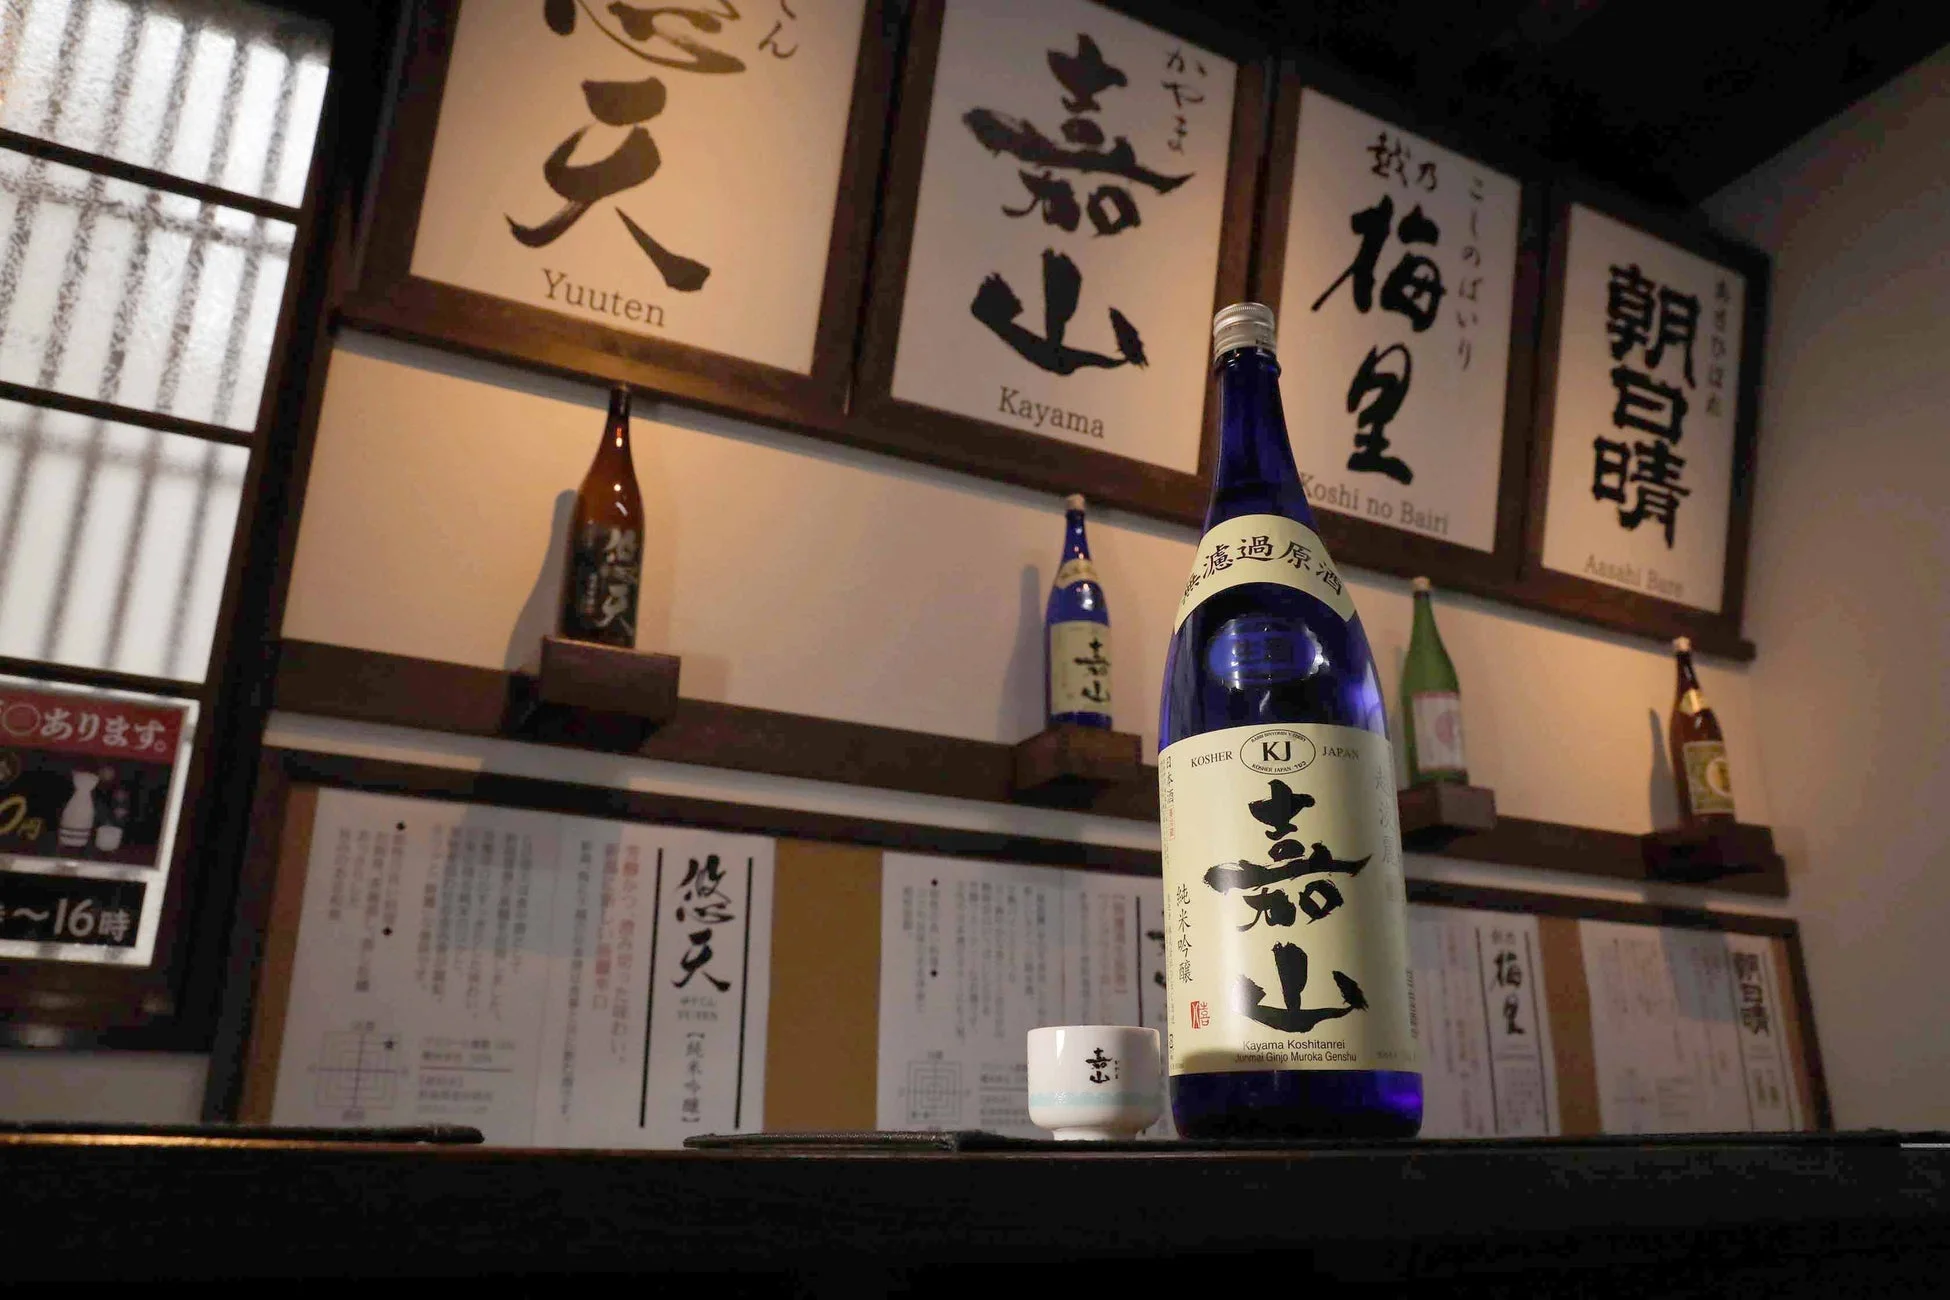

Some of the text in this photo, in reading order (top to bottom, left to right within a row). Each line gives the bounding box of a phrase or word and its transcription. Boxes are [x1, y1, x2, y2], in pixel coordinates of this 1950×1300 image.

[963, 33, 1196, 376] 嘉山
[541, 267, 667, 328] Yuuten
[1310, 194, 1447, 486] 梅里
[997, 386, 1106, 439] Kayama
[1591, 262, 1701, 550] 朝日晴
[1366, 496, 1394, 519] no
[1190, 751, 1234, 768] KOSHER
[1263, 741, 1292, 762] KJ
[1322, 746, 1360, 761] JAPAN
[1251, 763, 1273, 773] KOSHER
[1203, 778, 1373, 1033] 嘉山
[1235, 1051, 1357, 1064] Junmai Ginjo Muroka Genshu
[1243, 1039, 1346, 1052] Kayama Koshitanrei
[1085, 1047, 1113, 1084] 嘉山
